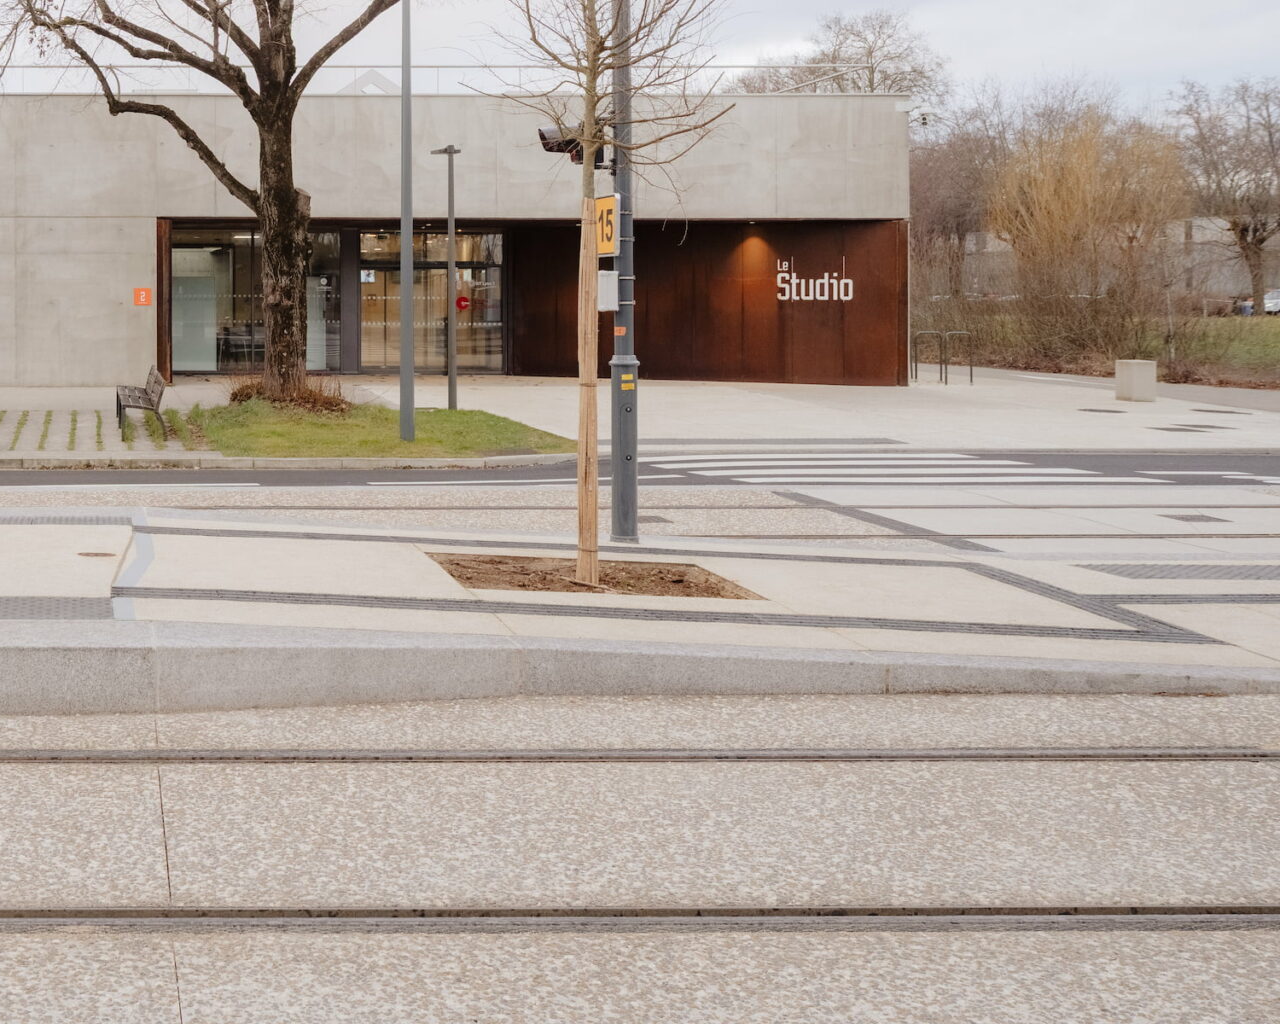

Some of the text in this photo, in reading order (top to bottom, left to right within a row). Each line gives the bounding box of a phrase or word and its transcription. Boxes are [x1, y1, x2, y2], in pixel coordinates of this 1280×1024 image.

[599, 209, 613, 242] 15
[777, 258, 789, 271] Le
[776, 272, 854, 301] Studio
